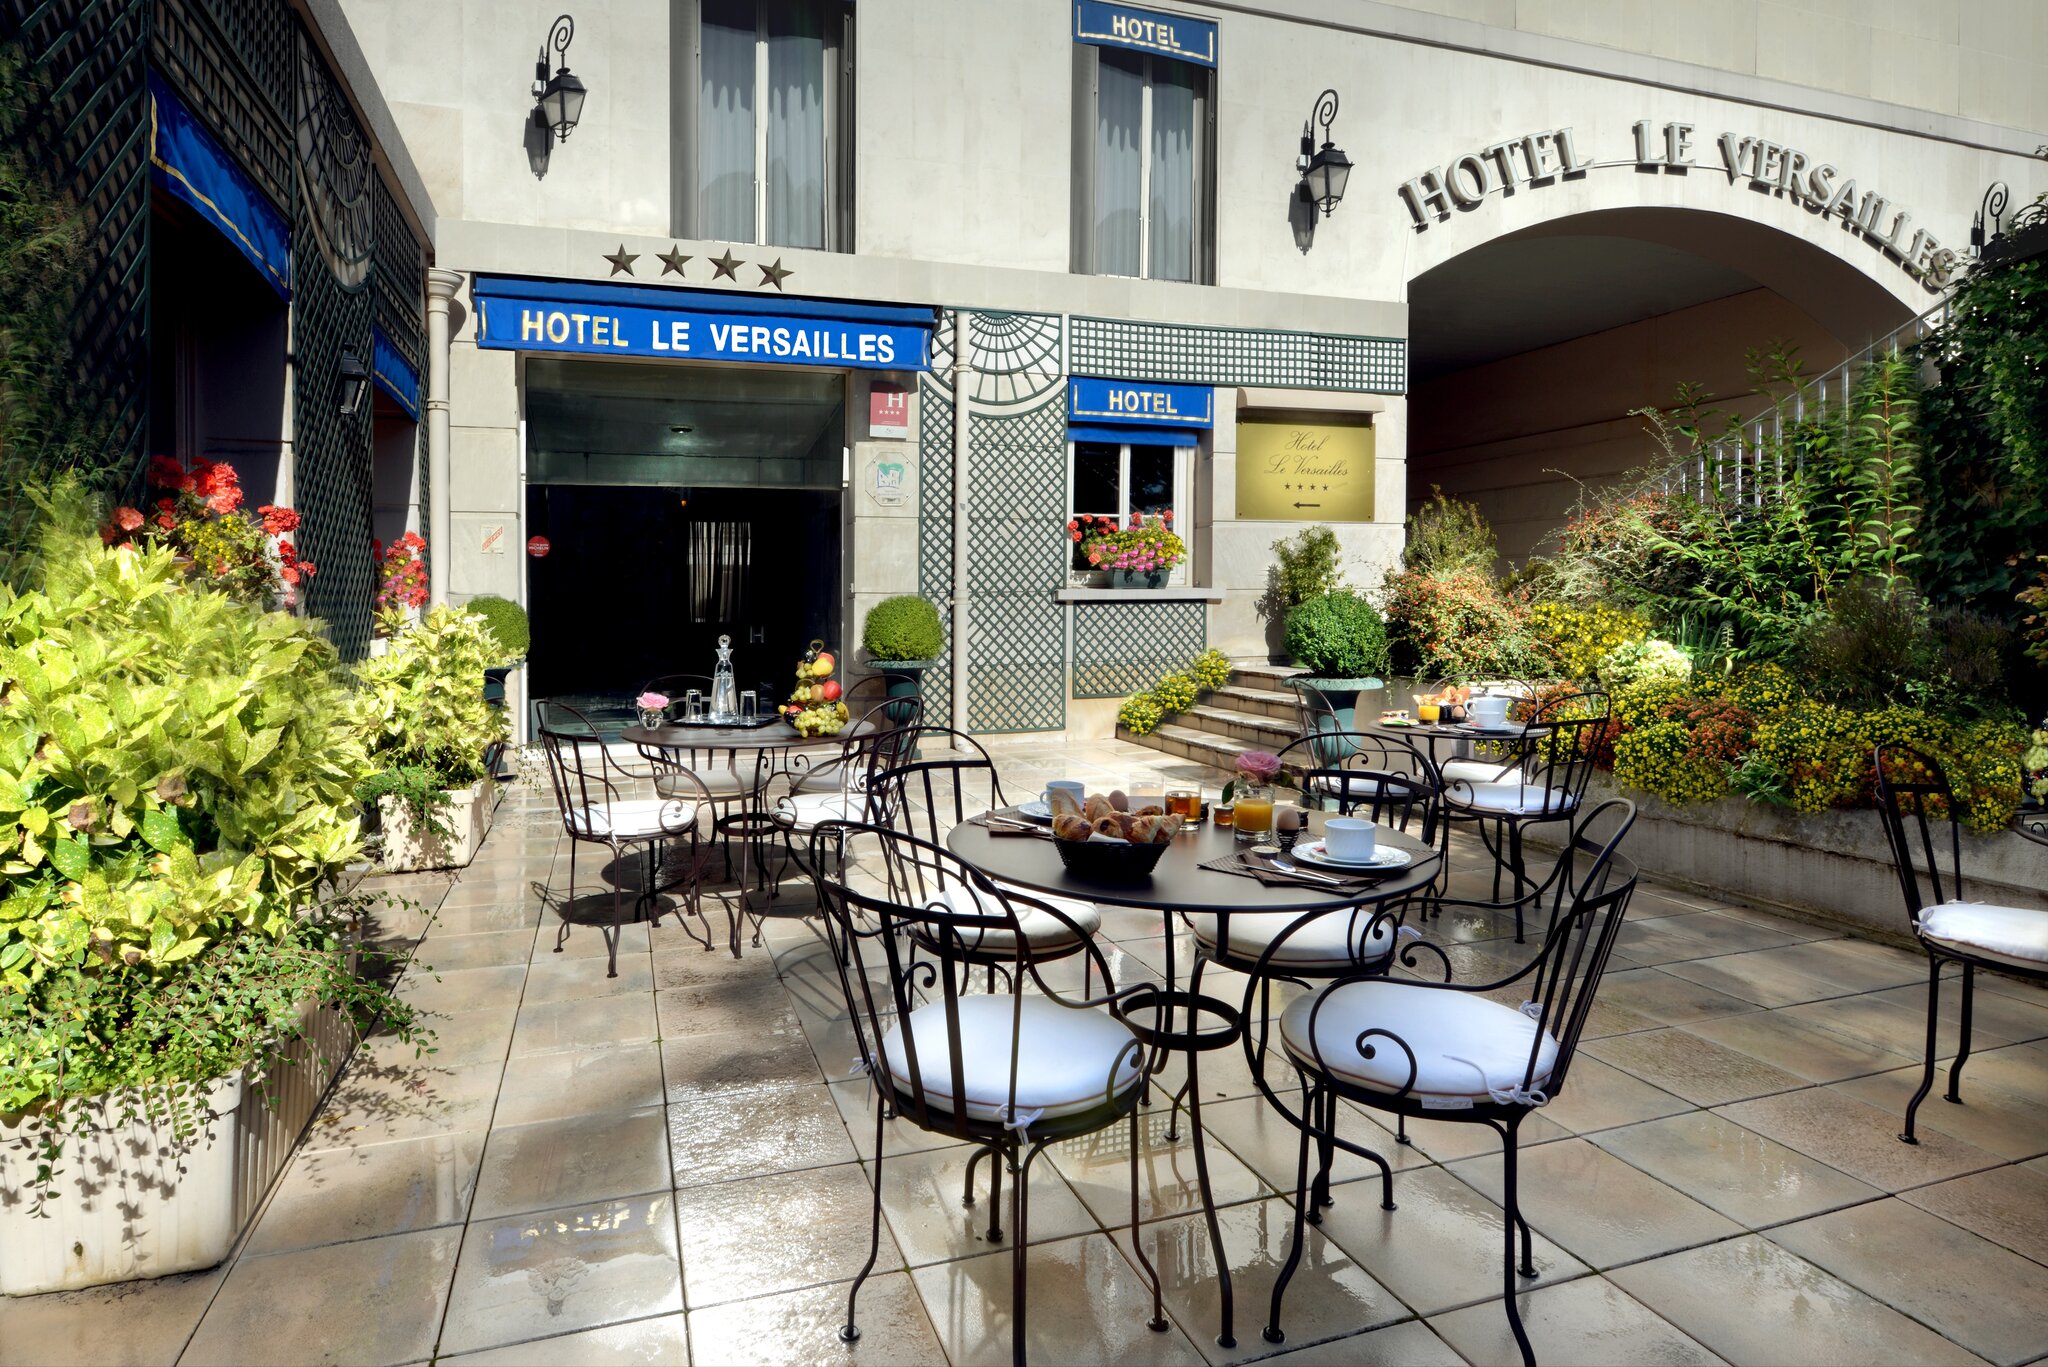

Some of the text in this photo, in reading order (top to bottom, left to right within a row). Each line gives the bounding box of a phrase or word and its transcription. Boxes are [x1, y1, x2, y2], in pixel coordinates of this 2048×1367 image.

[1112, 15, 1180, 48] HOTEL
[1400, 119, 1957, 290] HOTEL LE VERSAILLES
[521, 309, 895, 363] HOTEL LE VERSAILLES
[1108, 390, 1177, 414] HOTEL
[1285, 430, 1331, 452] Hotel
[1264, 454, 1349, 476] Le Versailles
